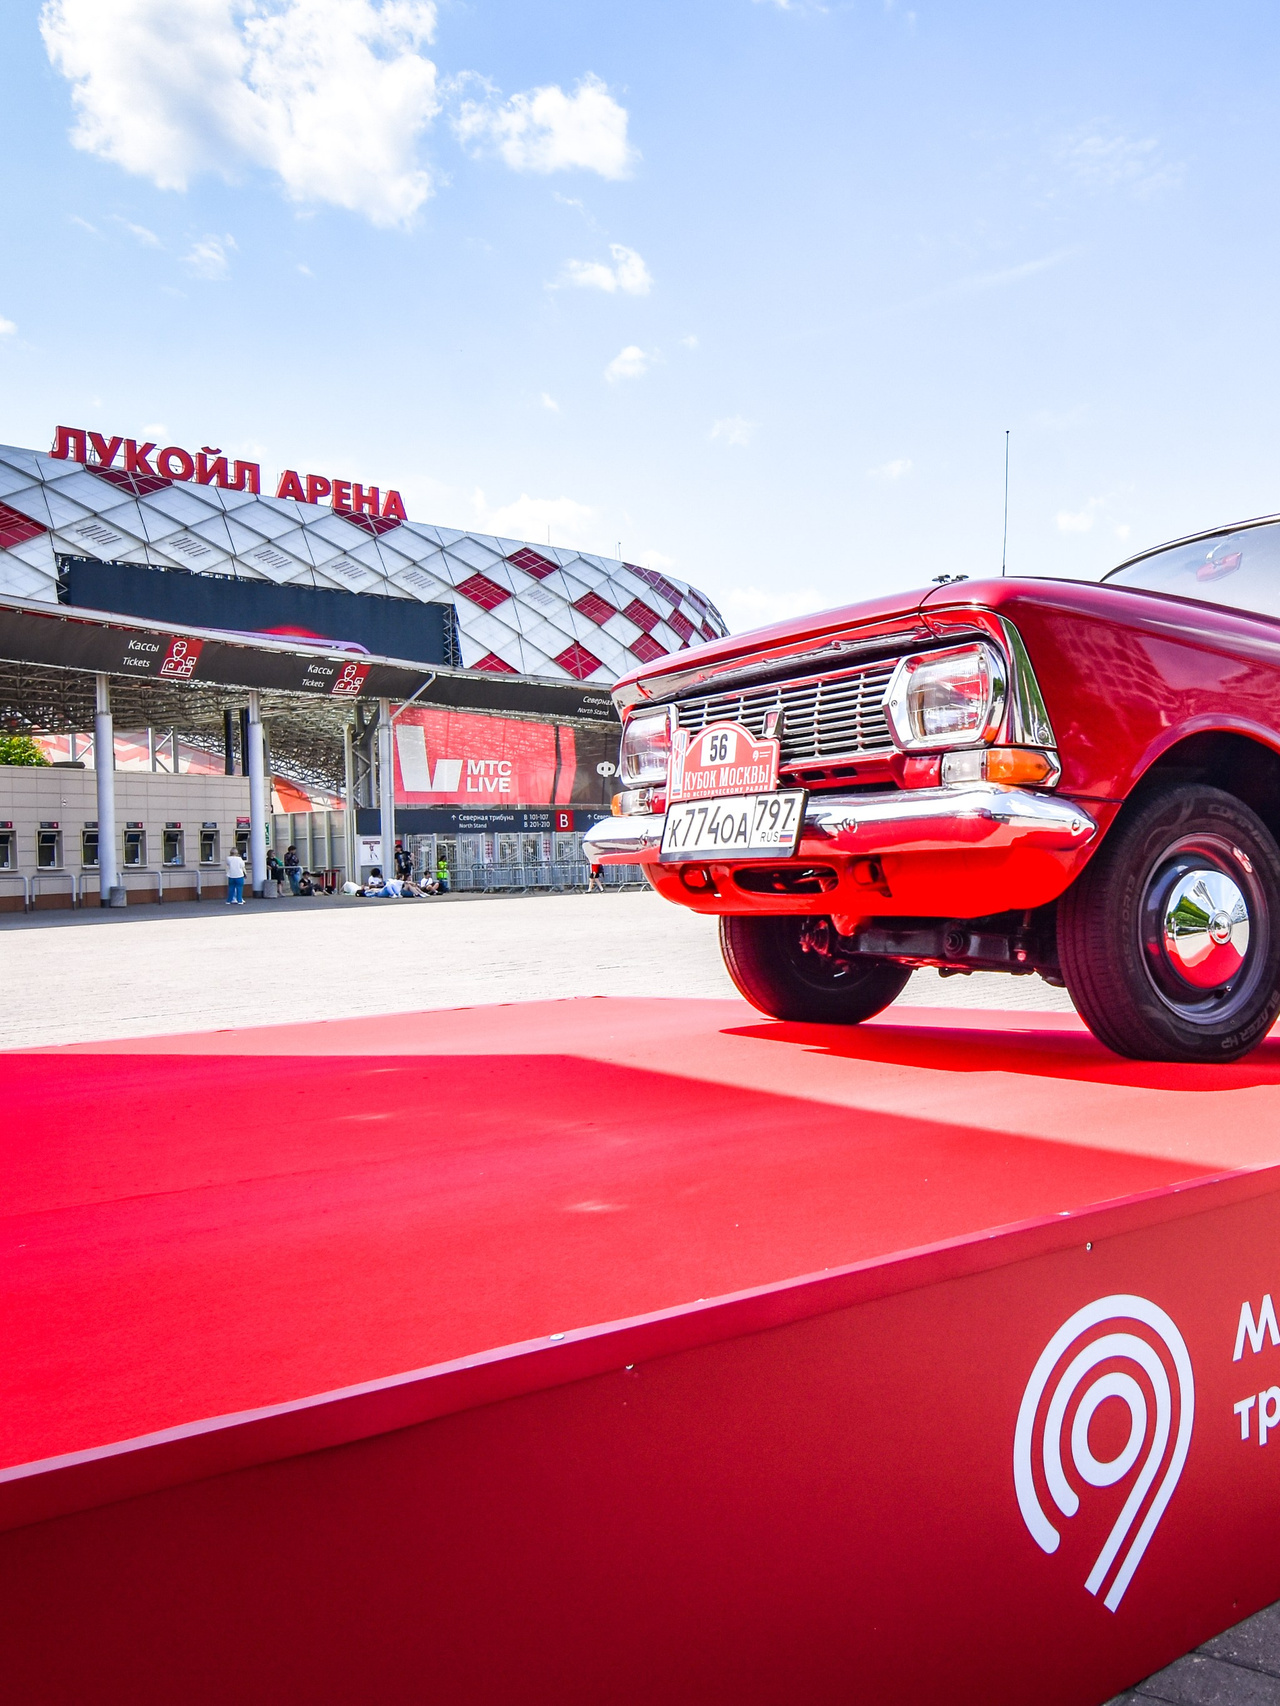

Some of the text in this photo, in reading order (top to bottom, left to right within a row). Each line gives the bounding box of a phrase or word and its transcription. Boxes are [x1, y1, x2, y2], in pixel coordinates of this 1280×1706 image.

[49, 425, 408, 521] ЛУКОЙЛ АРЕНА
[128, 640, 159, 652] Кассы
[122, 657, 151, 668] Tickets
[307, 664, 334, 675] Кассы
[301, 678, 325, 688] Tickets
[709, 733, 729, 762] 56
[467, 759, 512, 776] МТС
[684, 764, 770, 791] КУБОК МОСКВЫ
[467, 778, 511, 793] LIVE
[458, 814, 514, 822] Северная трибуна
[755, 798, 796, 831] 797
[760, 831, 779, 843] RUS
[1221, 990, 1280, 1049] BLAZER HP
